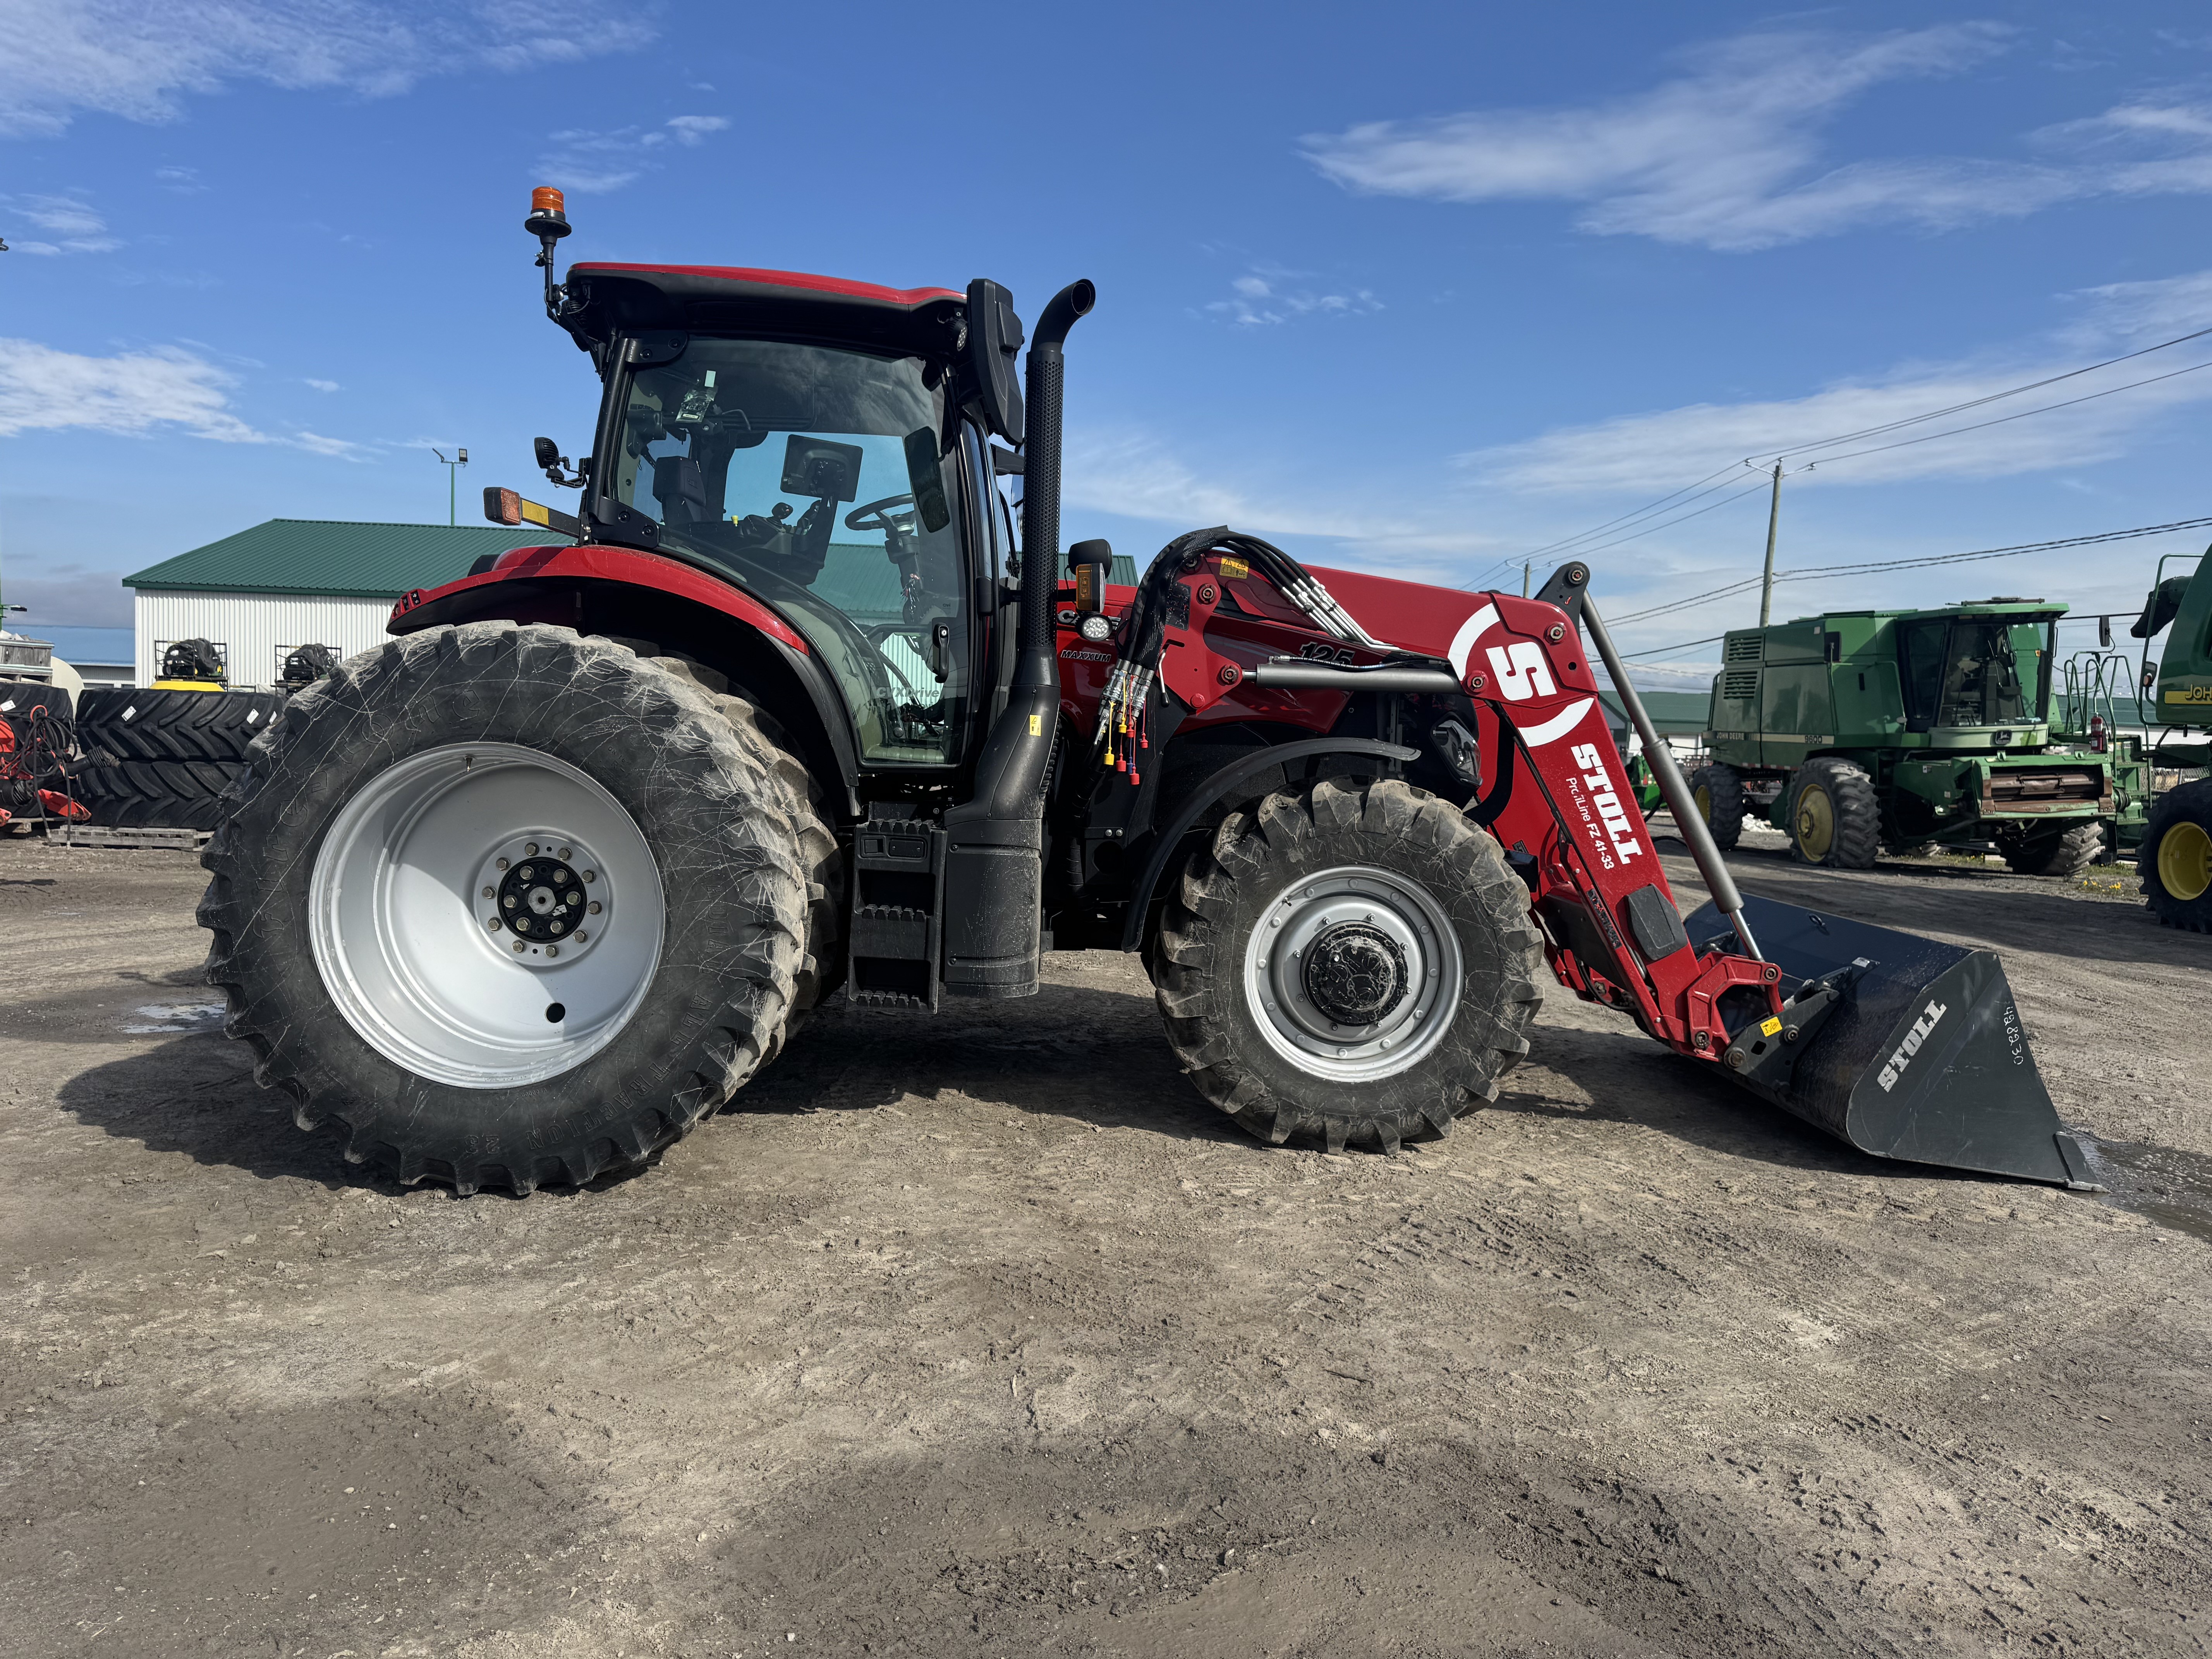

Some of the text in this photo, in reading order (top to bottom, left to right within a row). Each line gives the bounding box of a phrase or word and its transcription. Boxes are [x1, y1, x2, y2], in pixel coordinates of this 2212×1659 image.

[1060, 649, 1111, 663] MAXXUM
[1299, 641, 1355, 665] 125
[876, 687, 940, 698] CVXDrive
[1716, 732, 1745, 741] JOHN DEERE
[1805, 735, 1822, 744] 9600
[1571, 743, 1643, 864] STOLL
[1586, 823, 1601, 838] FZ
[1595, 840, 1614, 869] 41-33
[1877, 999, 1947, 1093] STOLL
